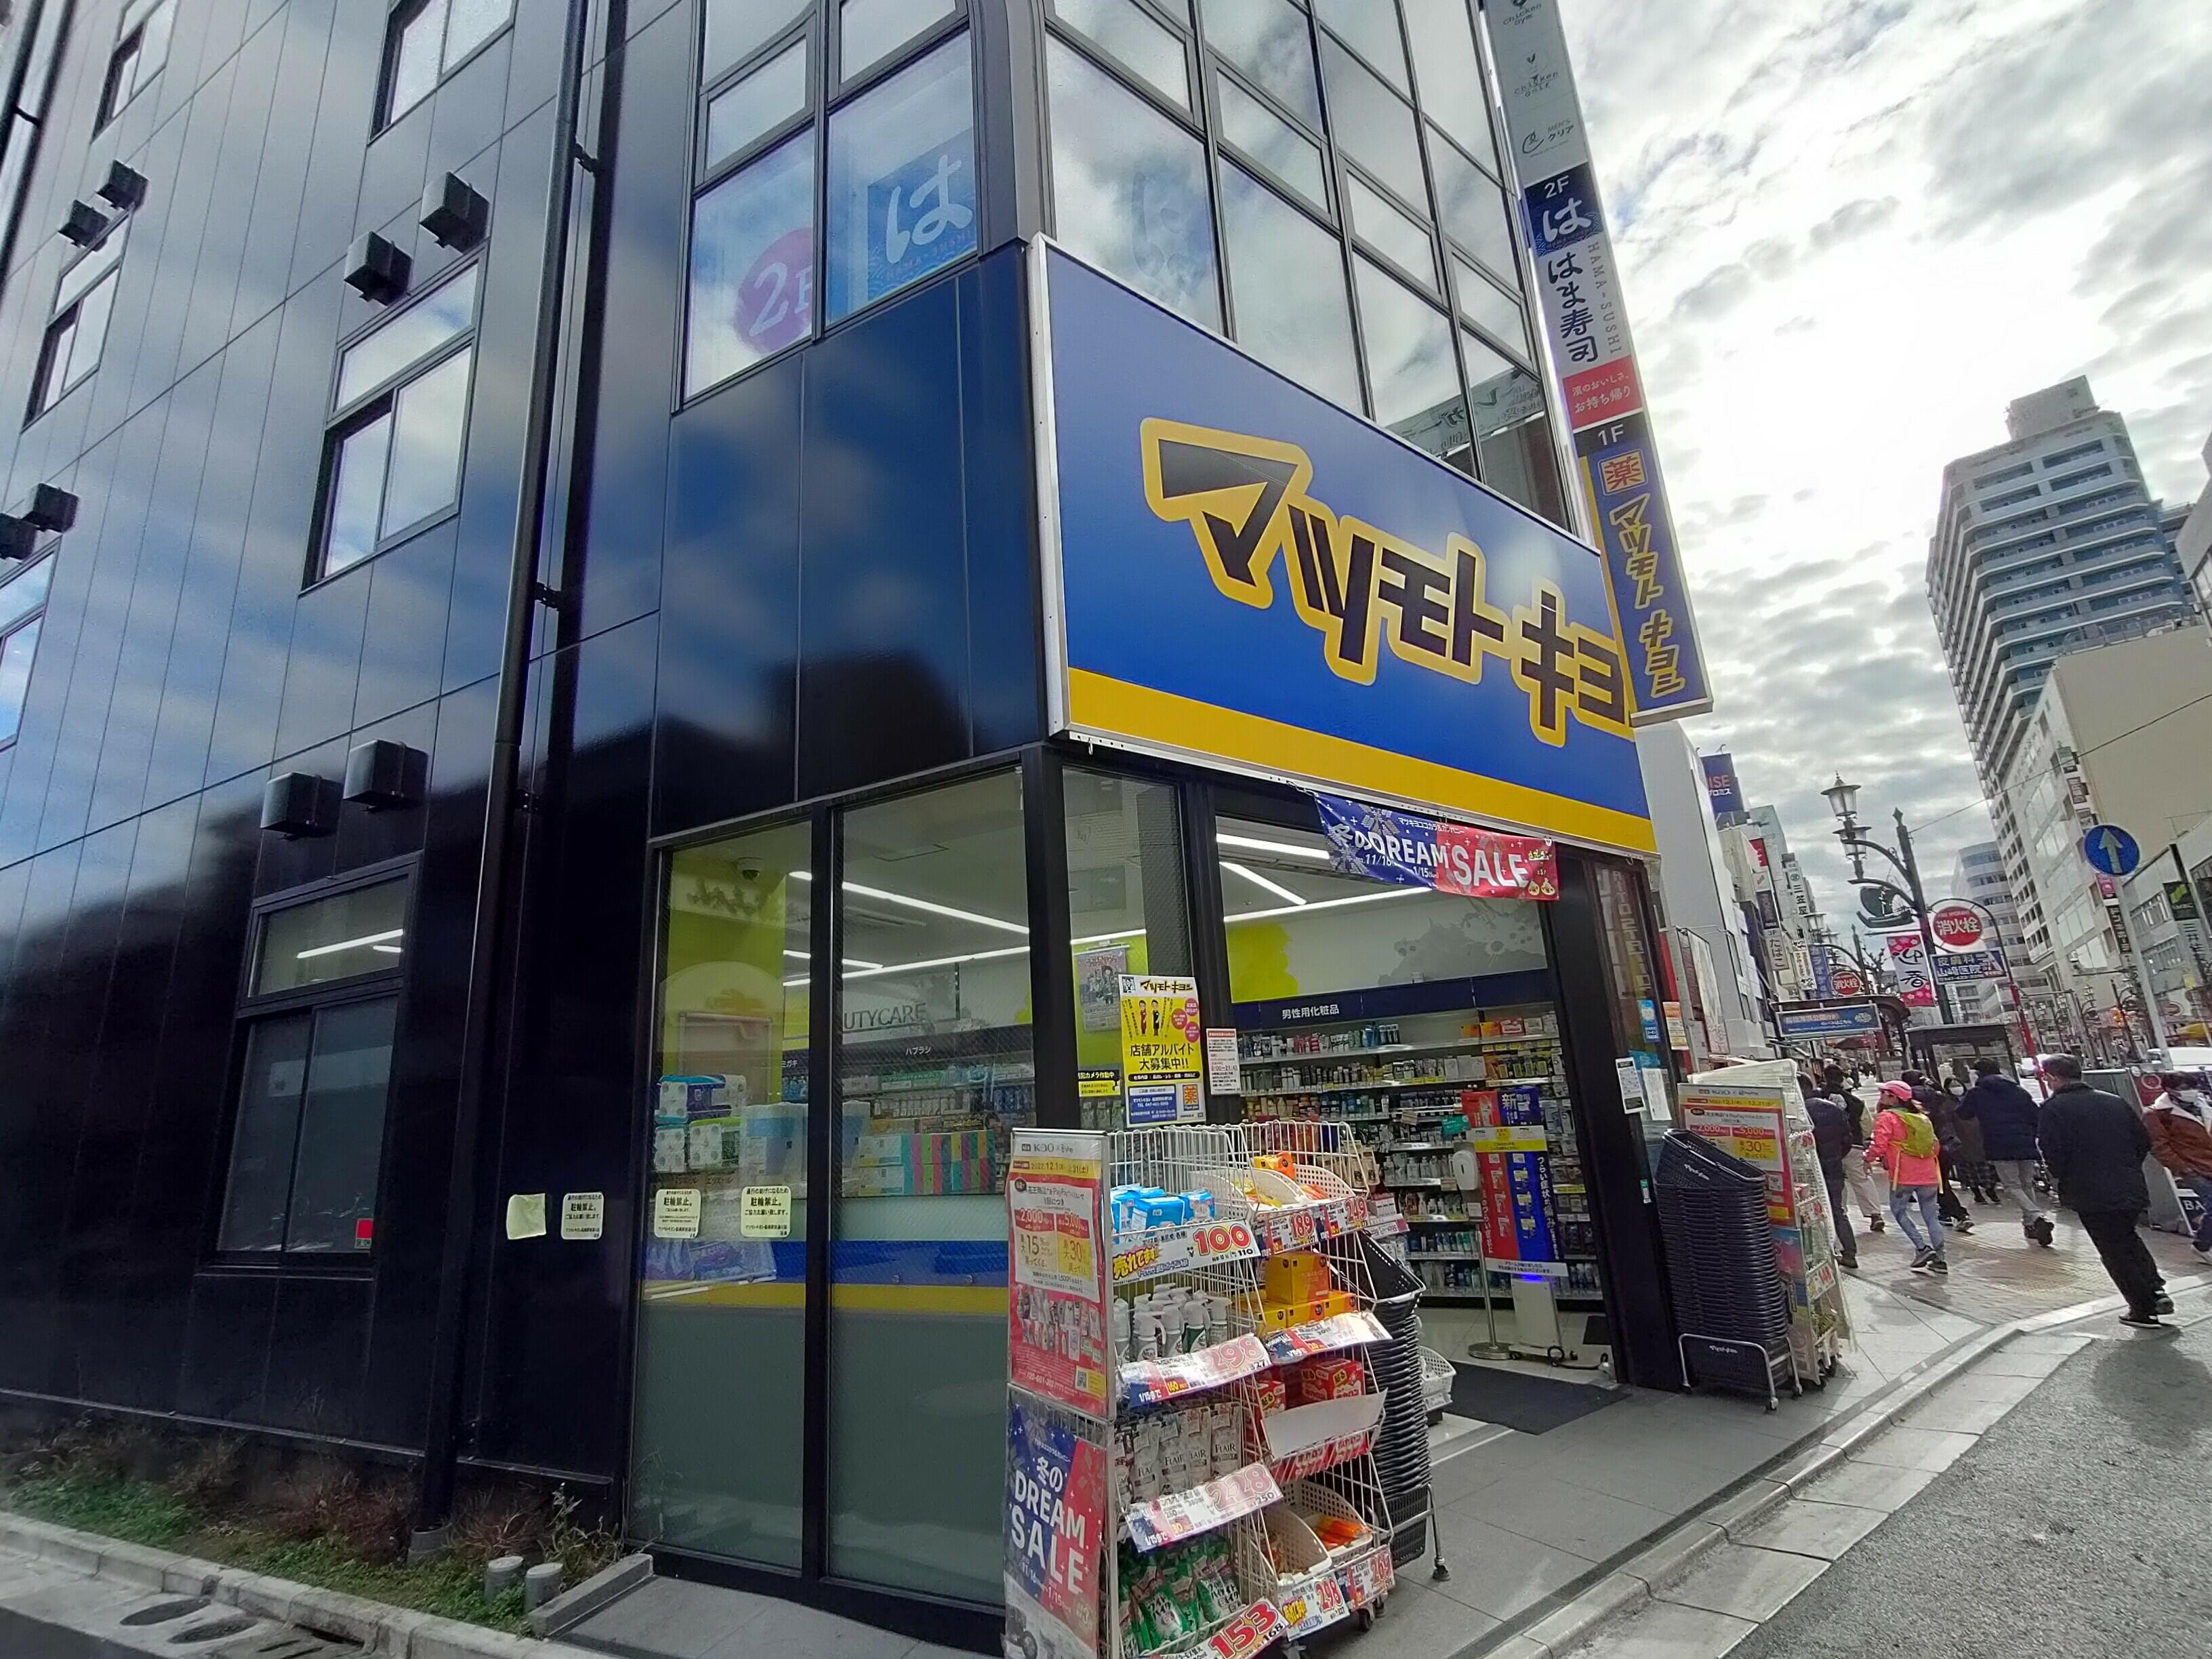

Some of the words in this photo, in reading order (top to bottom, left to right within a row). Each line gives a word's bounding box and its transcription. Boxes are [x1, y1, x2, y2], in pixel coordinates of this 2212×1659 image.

[1544, 175, 1570, 199] 2F
[886, 155, 973, 264] は
[1542, 197, 1592, 243] は
[1547, 251, 1599, 363] はま寿司
[1588, 241, 1622, 354] HAMA-SUSHI
[1574, 385, 1631, 413] お持ち帰り
[1597, 424, 1624, 446] 1F
[1610, 493, 1685, 698] マツモトキヨシ
[1709, 775, 1730, 787] ISE
[1368, 831, 1450, 869] DREAM
[1451, 844, 1530, 887] SALE
[1936, 917, 1980, 936] 消火栓
[1139, 980, 1193, 994] マツモトキヨシ
[1833, 979, 1860, 991] 消火栓
[844, 1003, 926, 1029] UTYCARE
[1282, 1004, 1340, 1019] 男性用化粧品
[905, 1046, 931, 1056] ハブラシ
[1130, 1043, 1194, 1057] 店舗アルバイト
[781, 1060, 798, 1068] ミガキ
[1501, 1093, 1517, 1110] 新
[1746, 1141, 1762, 1153] 30
[1019, 1207, 1044, 1223] 2,000
[1345, 1196, 1368, 1221] 249
[2182, 1200, 2207, 1211] BA
[1289, 1210, 1315, 1240] 189
[1026, 1235, 1040, 1256] 15
[1069, 1240, 1083, 1263] 30
[1193, 1223, 1251, 1256] 100
[1237, 1248, 1254, 1256] 110
[1206, 1336, 1264, 1374] 298
[1036, 1456, 1063, 1492] 冬の
[1206, 1465, 1273, 1512] 228
[1015, 1469, 1086, 1549] DREAM
[1011, 1504, 1085, 1595] SALE
[1315, 1576, 1343, 1612] 298
[1208, 1601, 1277, 1659] 153
